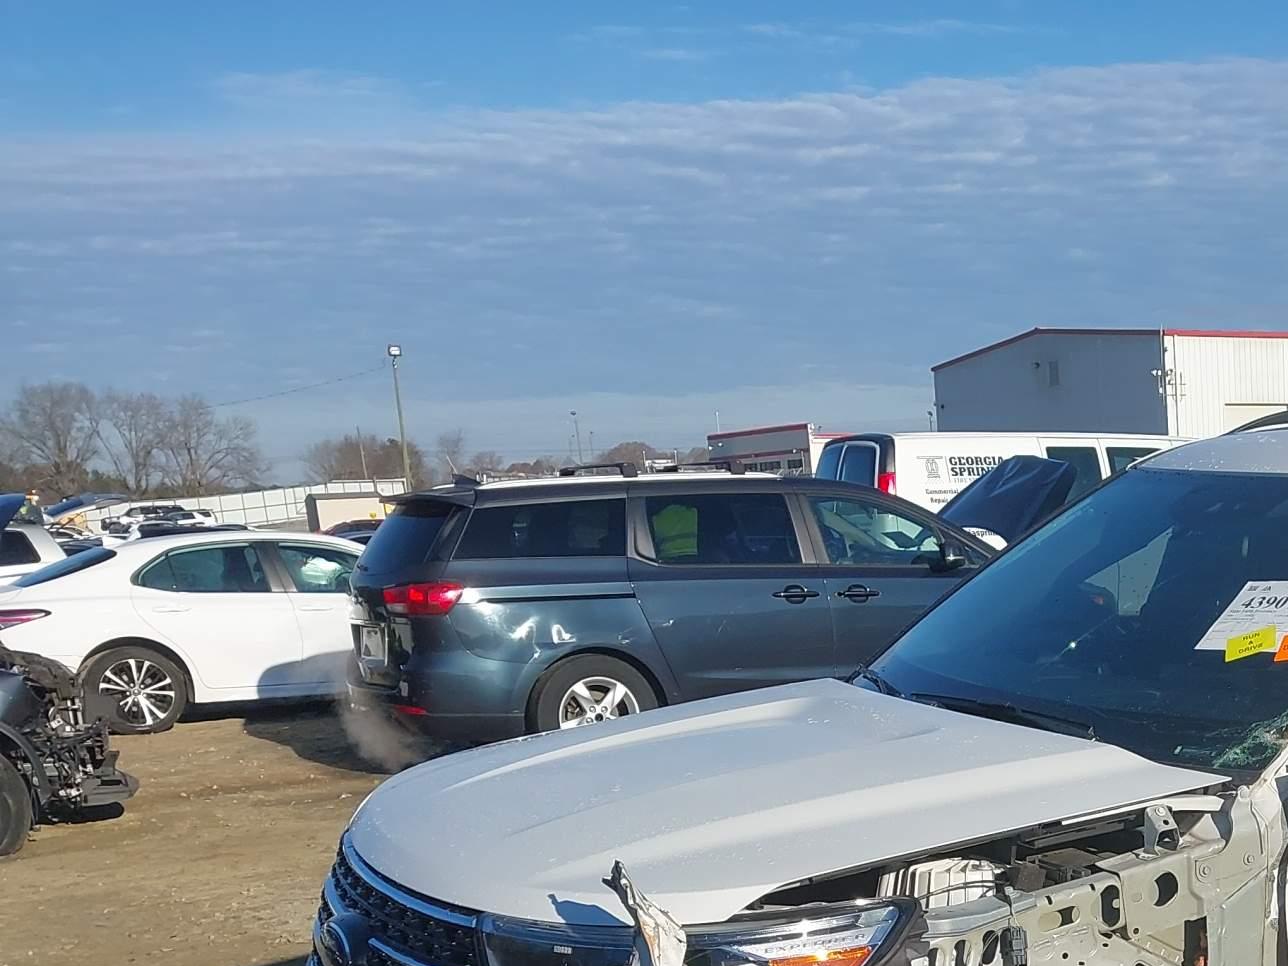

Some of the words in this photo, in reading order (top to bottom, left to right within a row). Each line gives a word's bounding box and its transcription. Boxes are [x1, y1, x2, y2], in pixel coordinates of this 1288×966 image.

[949, 456, 1004, 466] GEORGIA
[950, 466, 994, 477] SPRIN
[1242, 632, 1260, 641] RUN
[1238, 642, 1264, 654] DRIVE
